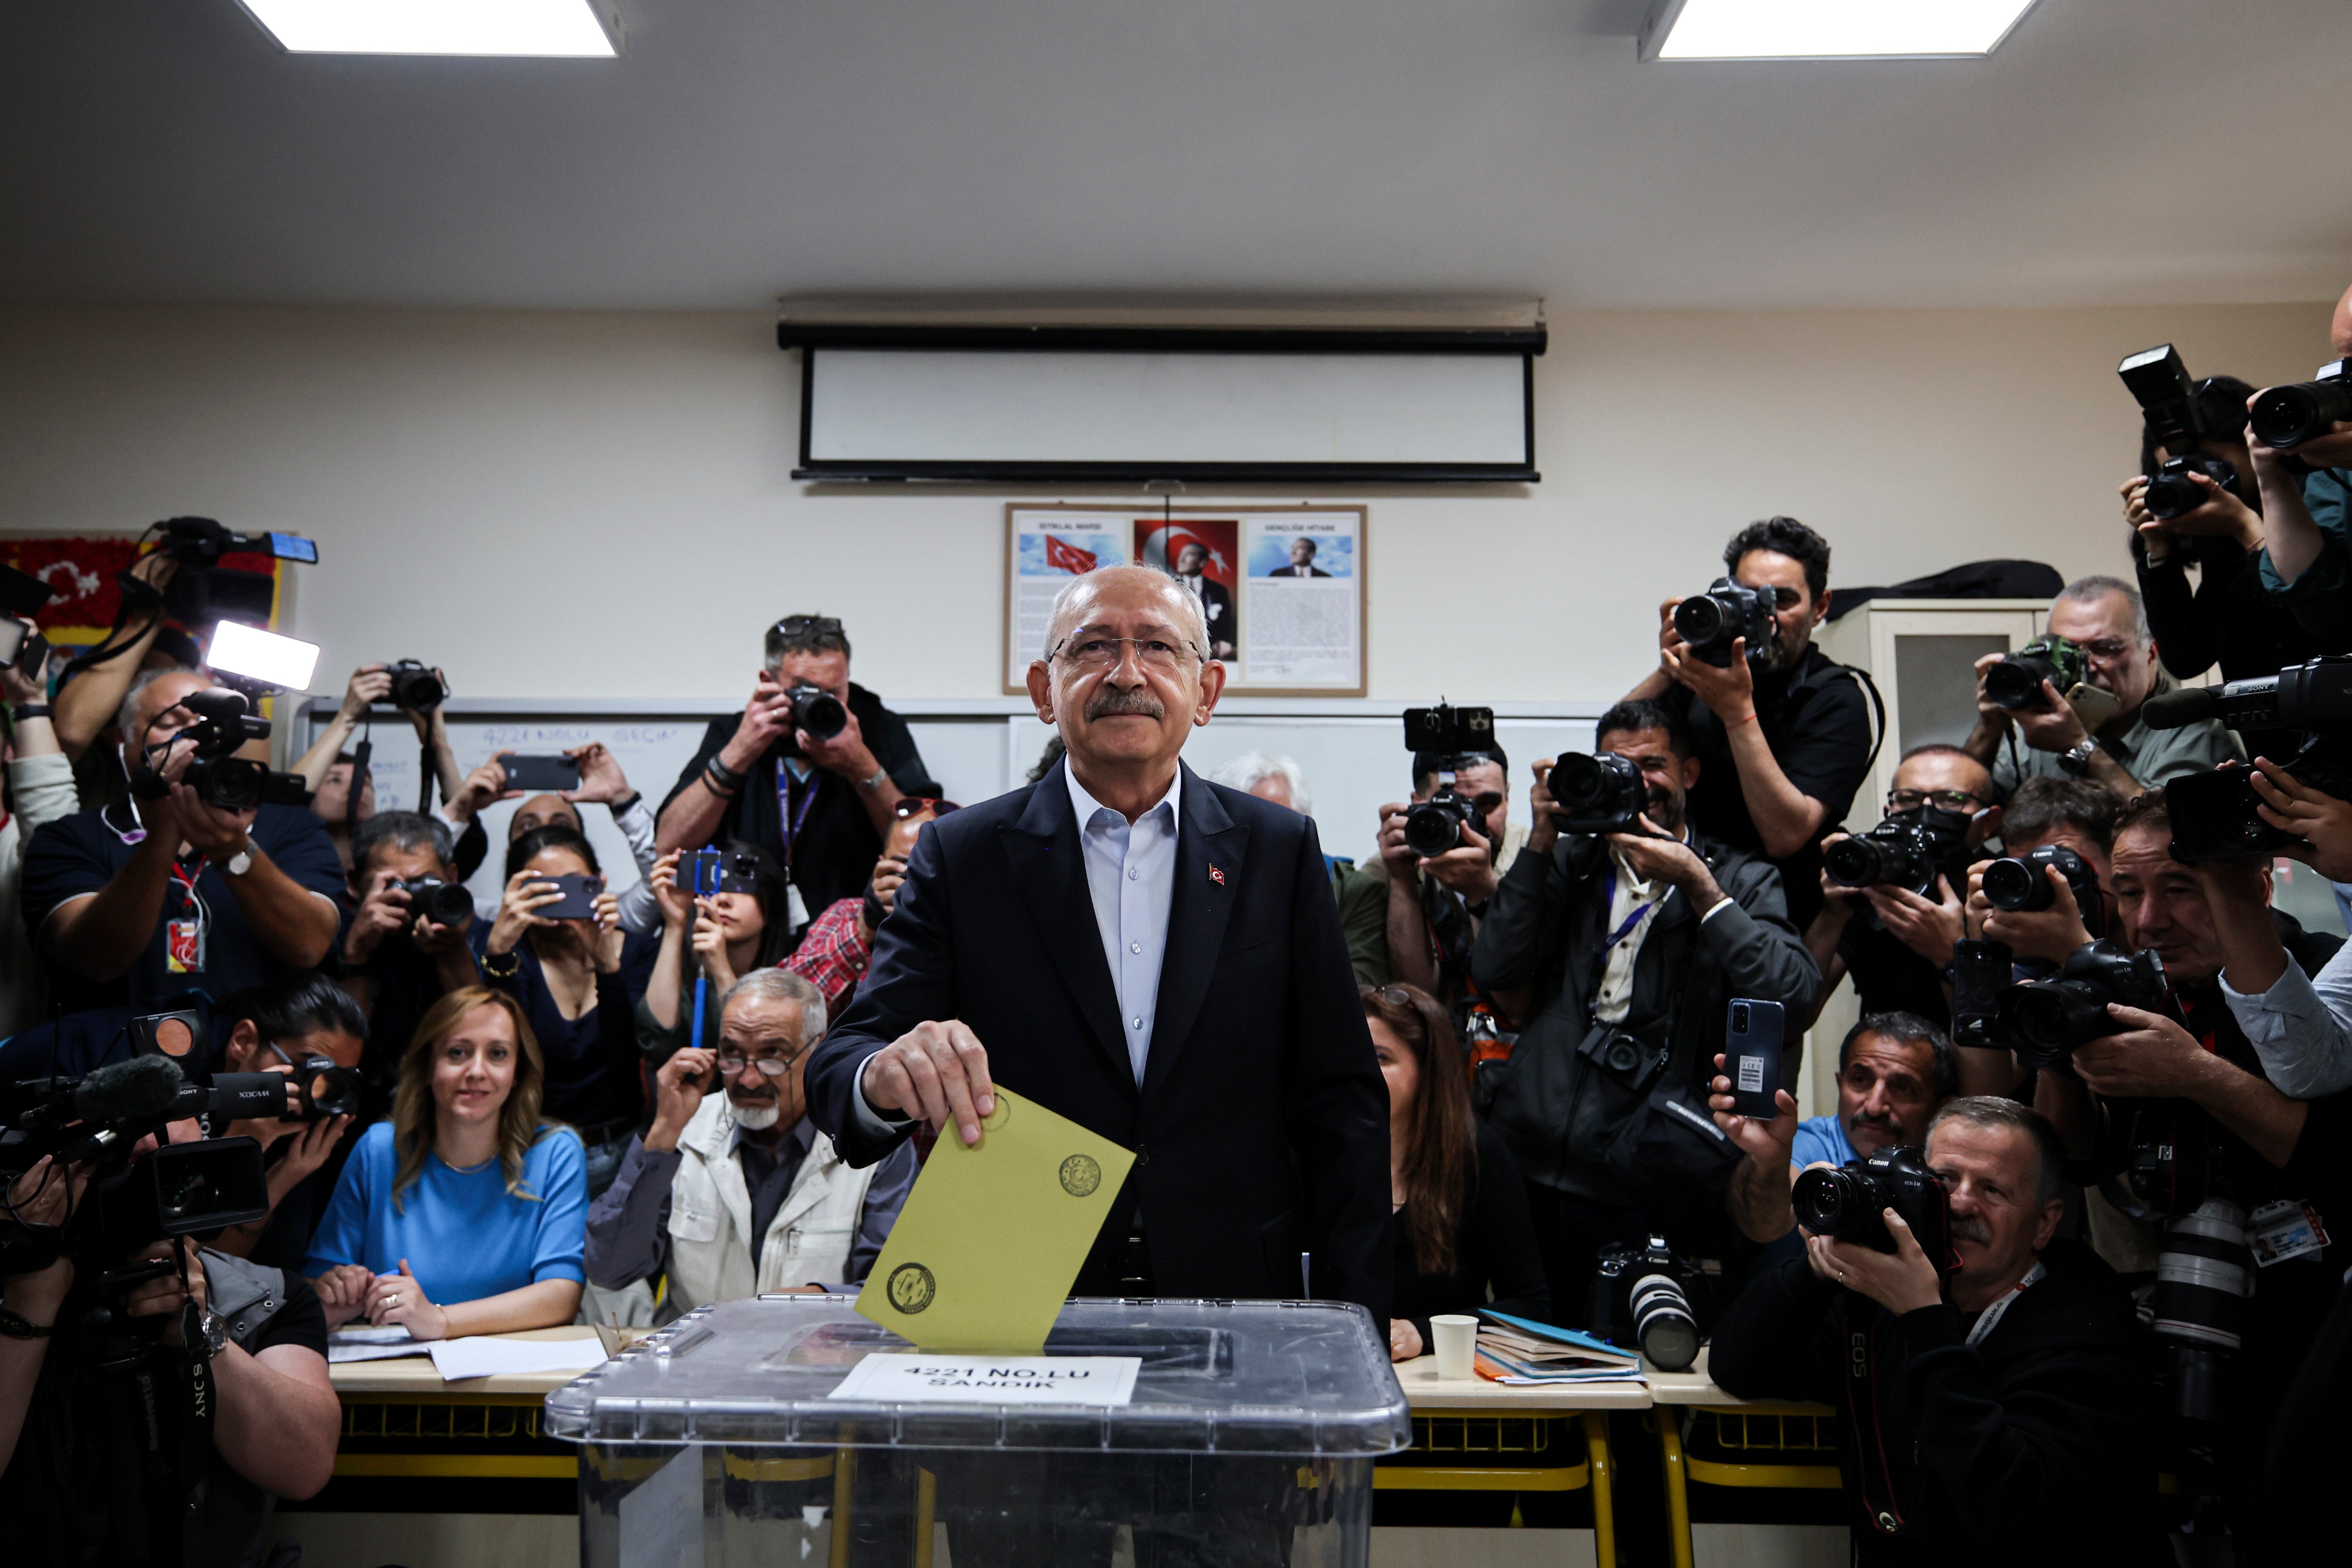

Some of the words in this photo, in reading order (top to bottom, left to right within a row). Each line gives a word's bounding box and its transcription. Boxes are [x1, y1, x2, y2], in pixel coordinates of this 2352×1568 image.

[1868, 1158, 1889, 1166] Canon
[1852, 1332, 1867, 1378] EOS
[904, 1367, 974, 1376] 4221
[989, 1368, 1090, 1379] NO.LU
[928, 1378, 1056, 1388] SANDIK
